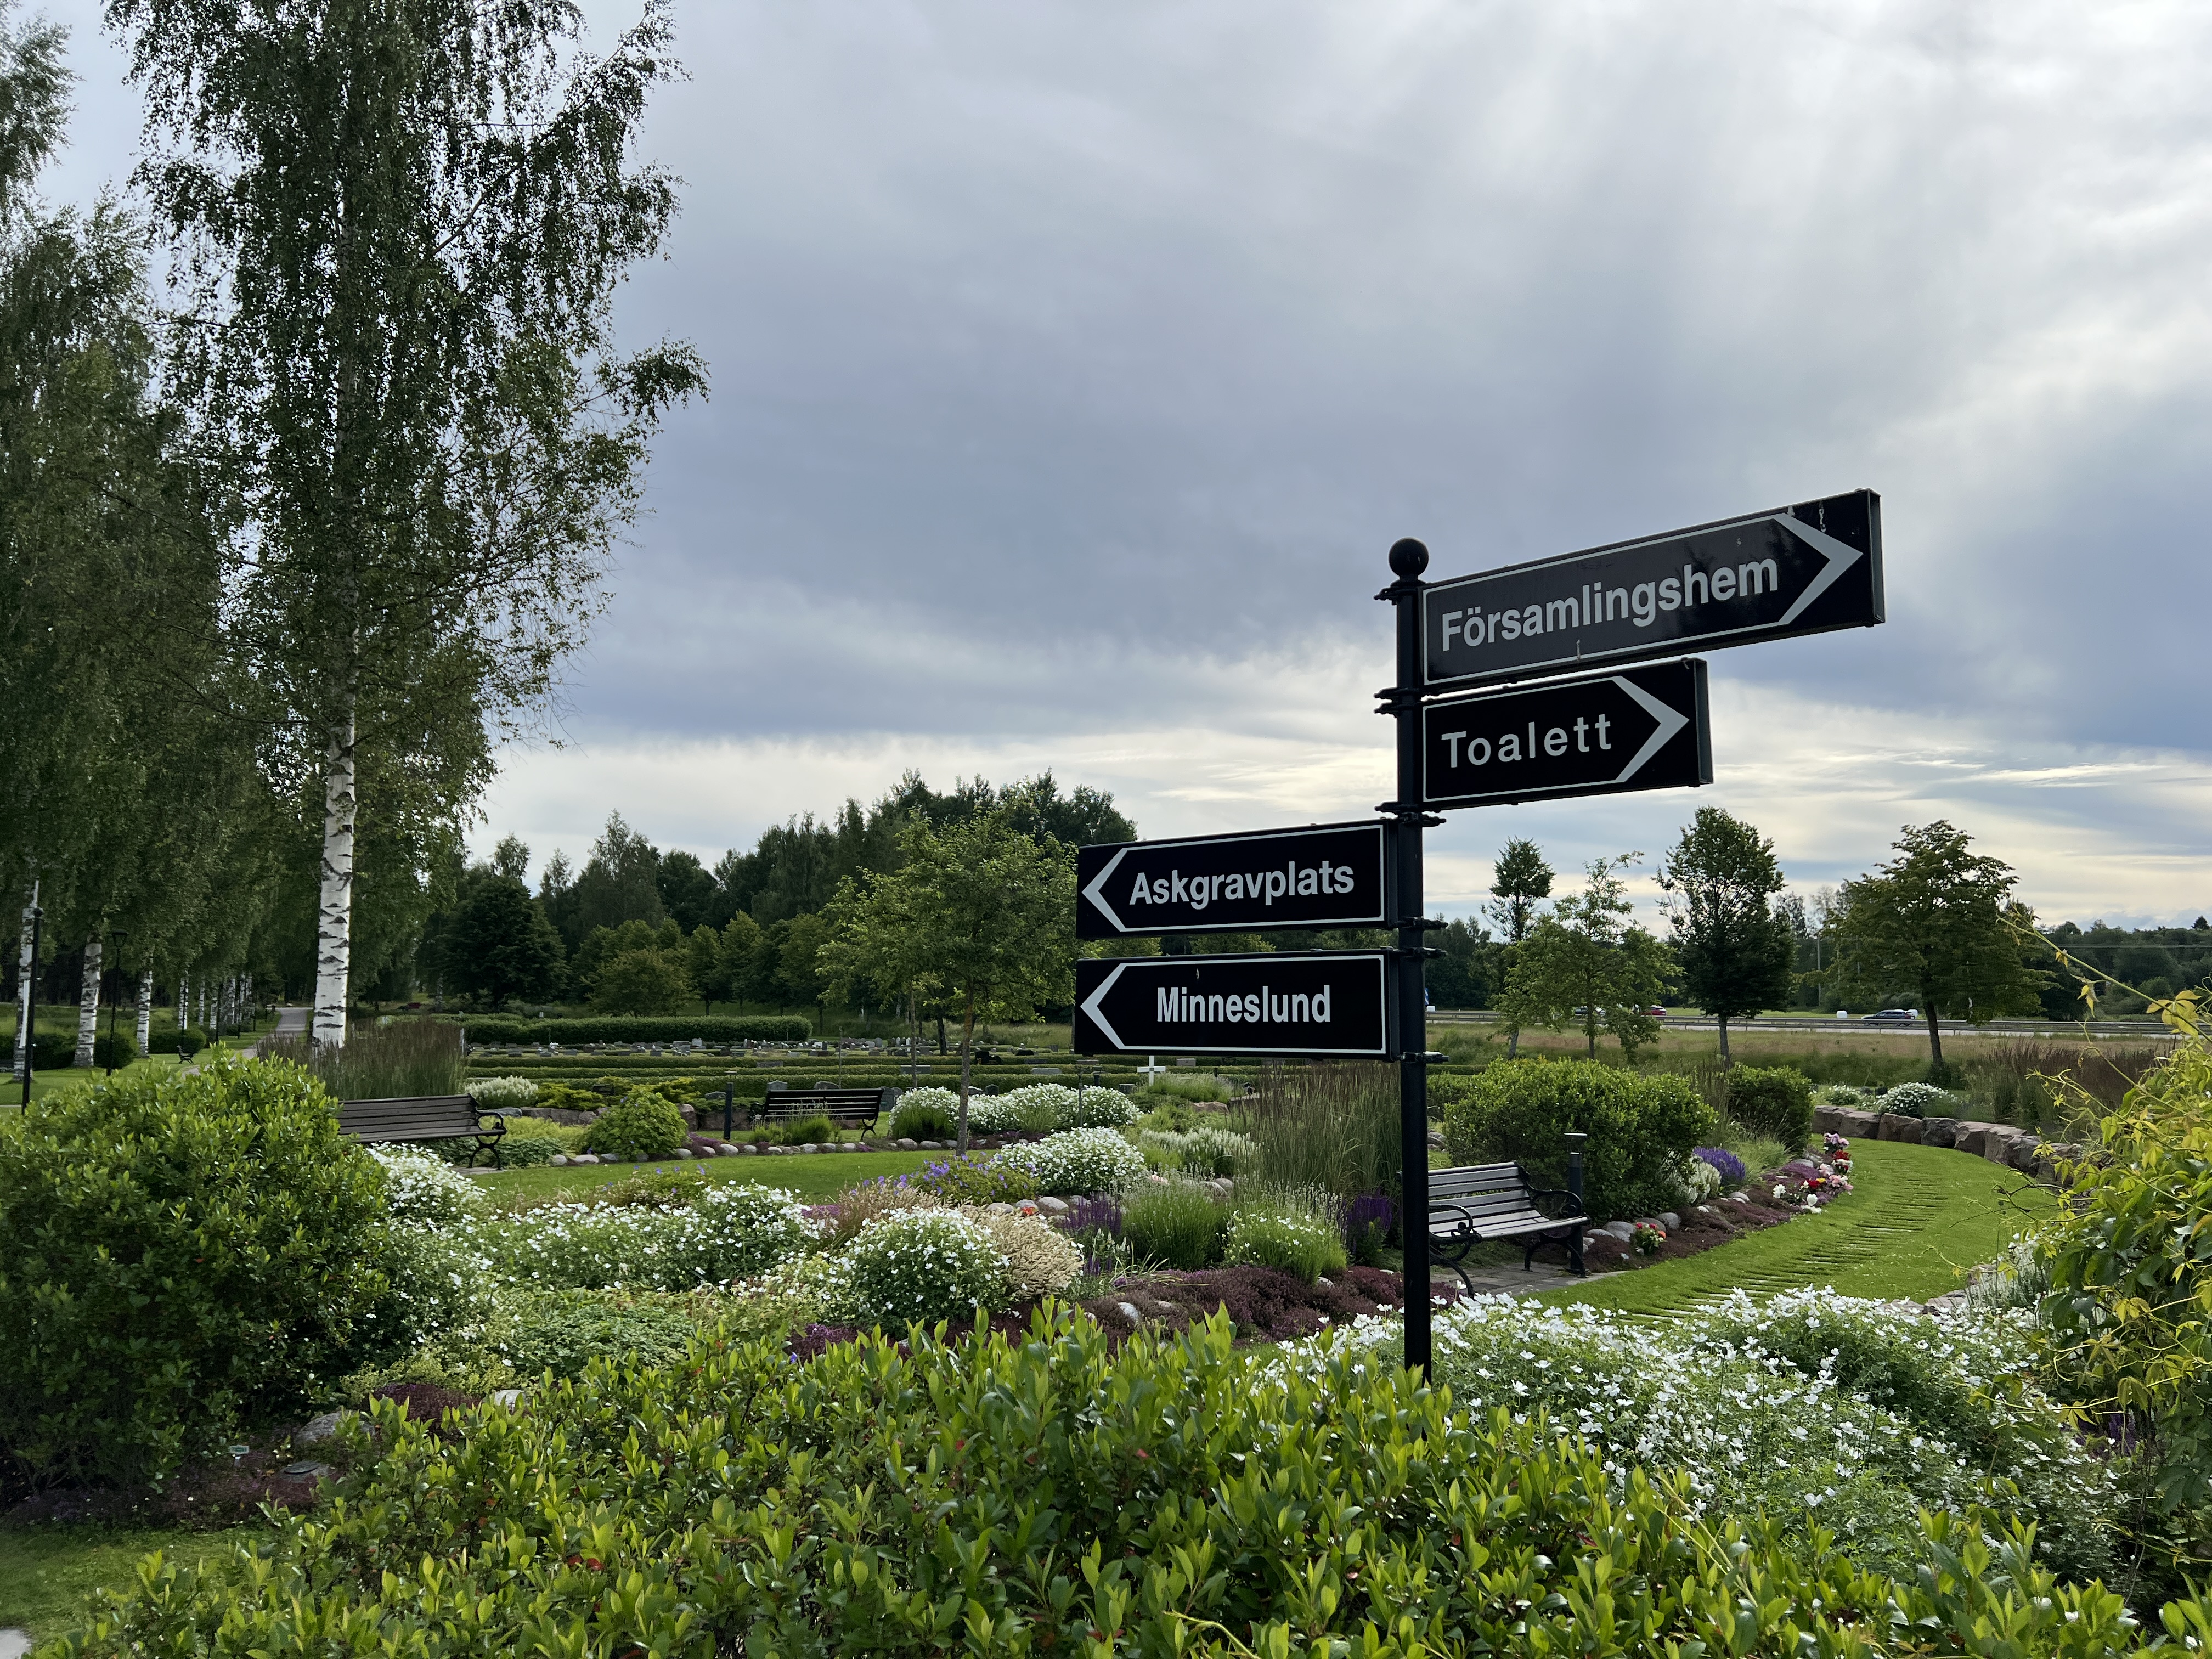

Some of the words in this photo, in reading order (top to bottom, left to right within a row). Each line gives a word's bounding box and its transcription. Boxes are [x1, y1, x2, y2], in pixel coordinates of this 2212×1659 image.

[1441, 558, 1779, 652] Församlingshem
[1441, 714, 1612, 769] Toalett
[1128, 860, 1355, 910] Askgravplats
[1156, 984, 1331, 1023] Minneslund
